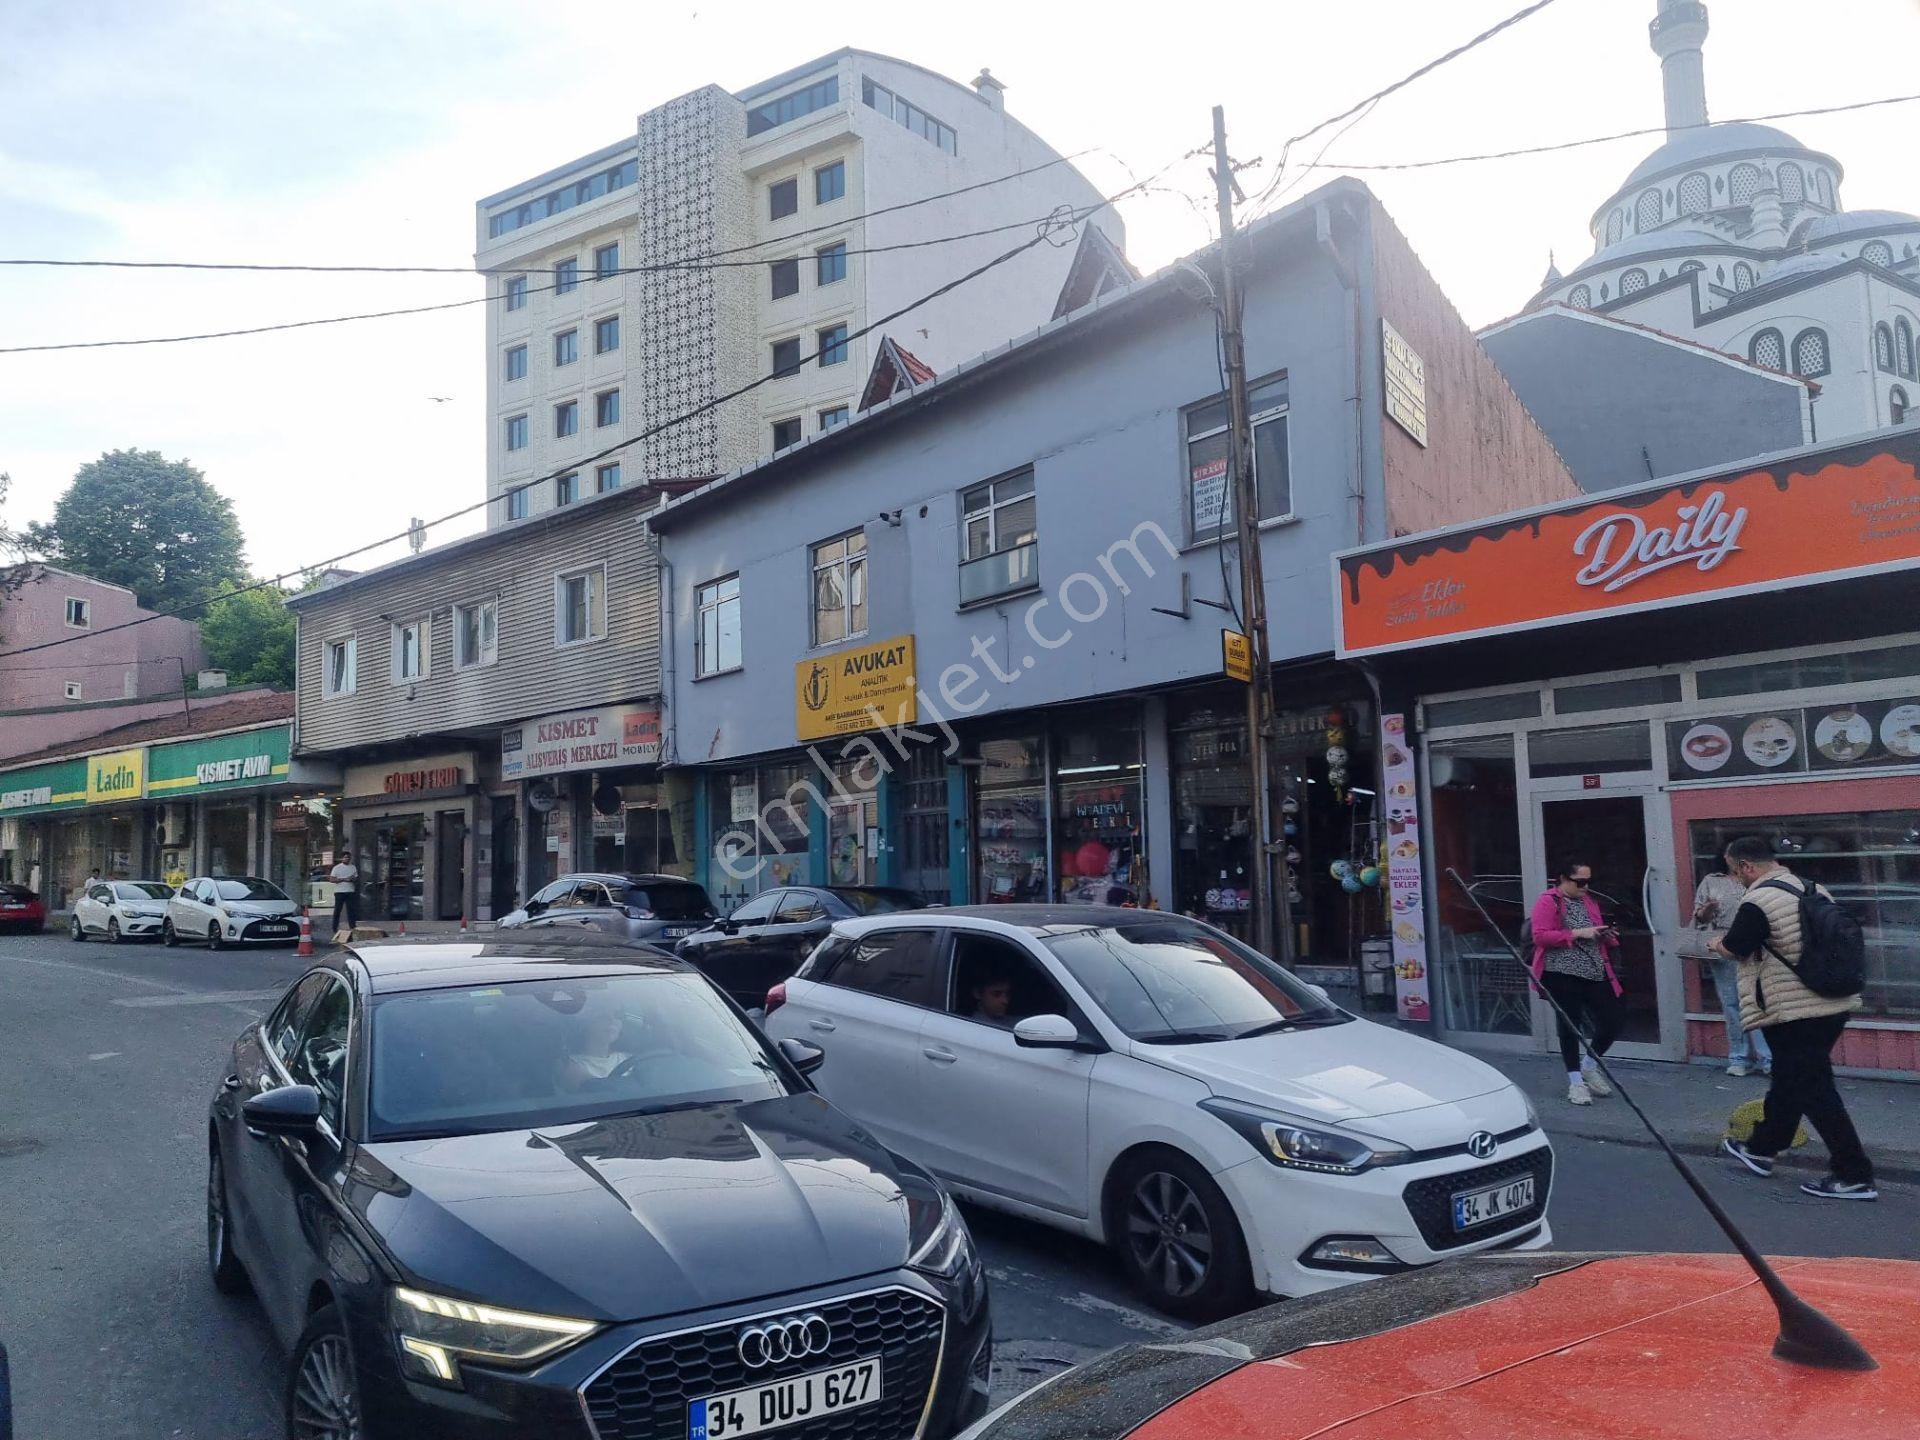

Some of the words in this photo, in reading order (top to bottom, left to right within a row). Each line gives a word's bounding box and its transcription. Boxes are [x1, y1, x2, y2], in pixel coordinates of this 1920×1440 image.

[1193, 461, 1227, 479] KIRALI
[1573, 490, 1748, 586] Daily
[844, 646, 906, 676] AVUKAT
[537, 716, 599, 744] KISMET
[624, 720, 658, 737] Ladin
[197, 758, 242, 784] KISMET
[242, 755, 270, 778] AVM
[527, 746, 568, 772] ALIŞVERİŞ
[571, 739, 618, 763] MERKEZİ
[96, 766, 135, 793] Ladin
[1394, 881, 1418, 889] EKLER
[1464, 1197, 1479, 1223] 34
[1486, 1191, 1500, 1216] JK
[1506, 1181, 1532, 1209] 4074
[691, 1426, 705, 1437] TR
[708, 1398, 744, 1437] 34
[760, 1380, 812, 1426] DUJ
[825, 1364, 873, 1409] 627
